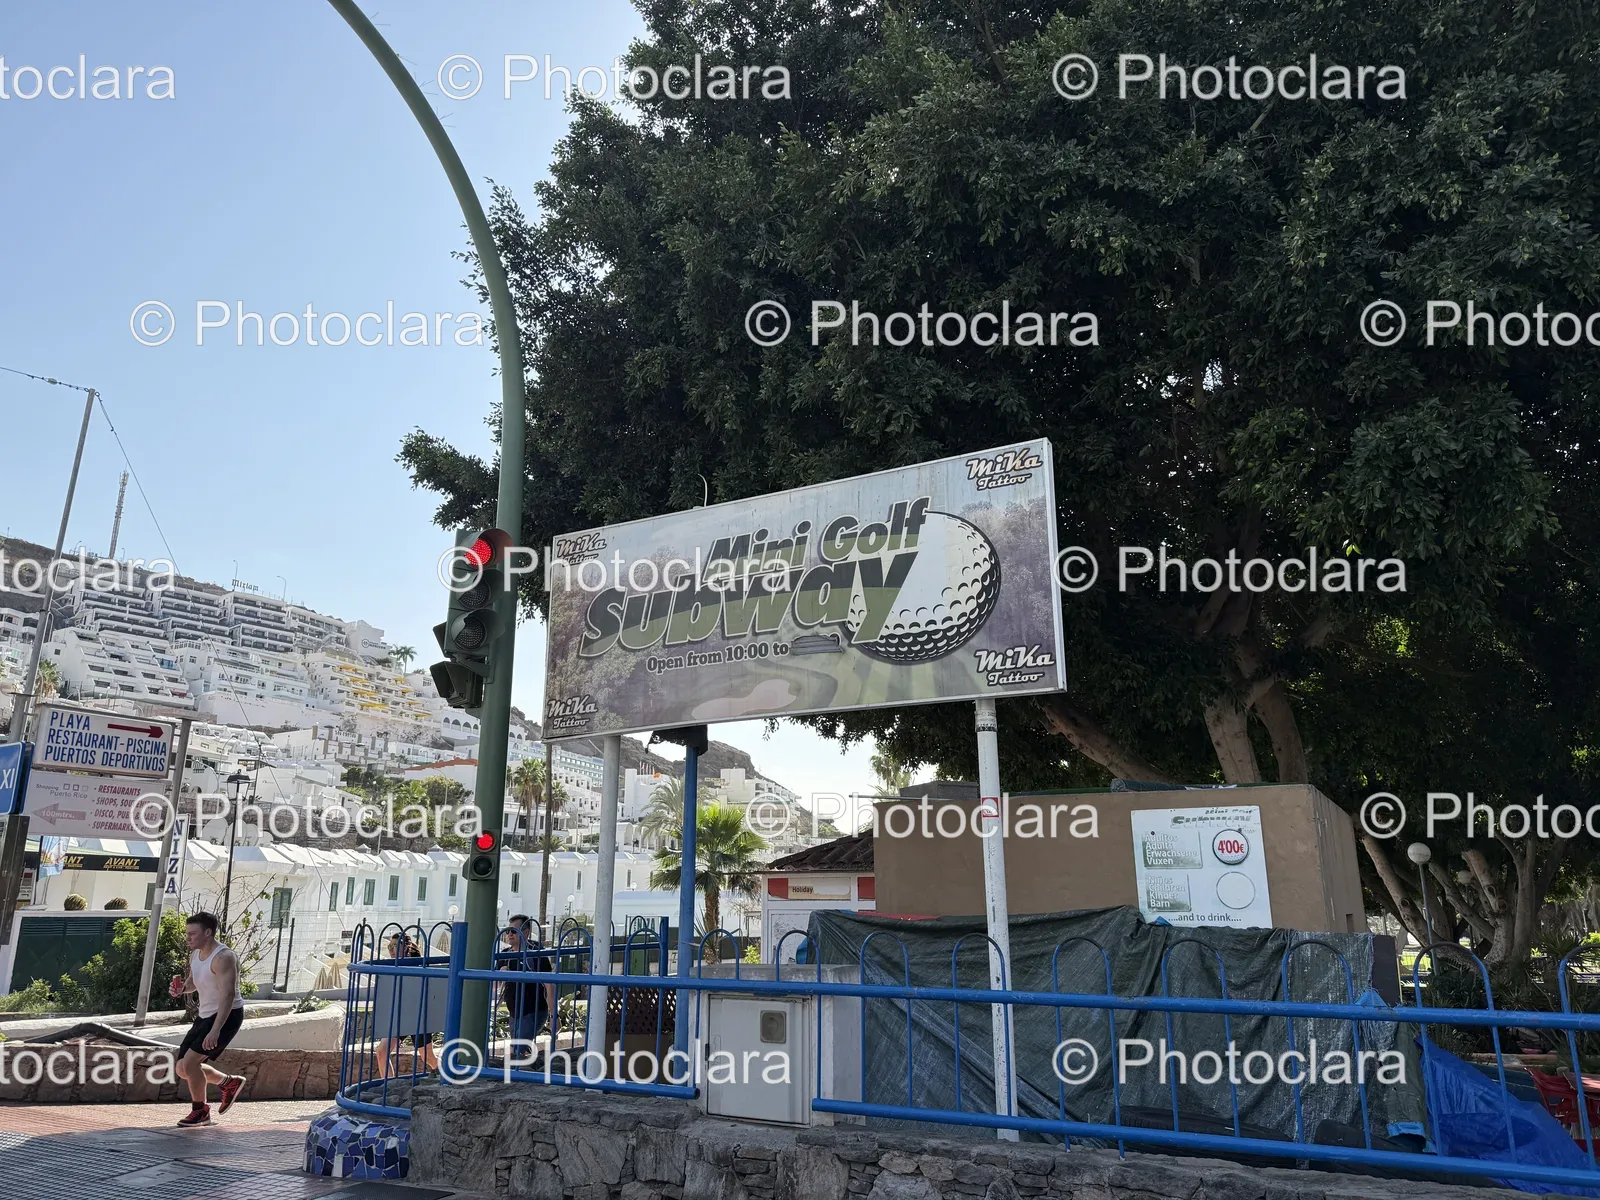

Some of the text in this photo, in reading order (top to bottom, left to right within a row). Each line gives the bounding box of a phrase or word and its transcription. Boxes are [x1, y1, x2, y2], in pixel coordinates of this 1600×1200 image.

[977, 473, 1032, 491] Tattoo
[703, 496, 931, 582] Mini Golf
[646, 641, 789, 675] Open from 10:00 to
[987, 671, 1045, 686] Tattoo
[50, 711, 91, 731] PLAYA
[552, 717, 589, 730] Tattoo
[44, 746, 166, 772] PUERTOS DEPORTIVOS
[36, 783, 60, 791] Shopping
[98, 785, 141, 796] RESTAURANTS
[50, 790, 88, 799] Puerto Rico
[96, 798, 118, 808] SHOPS,
[42, 810, 75, 819] 100mtrs.
[94, 810, 115, 820] DISCO,
[1145, 841, 1174, 850] Adults
[165, 818, 185, 894] NIZA
[104, 857, 140, 866] AVANT
[1147, 857, 1174, 865] Vuxen
[792, 886, 813, 894] Holiday
[1148, 883, 1186, 892] Children
[1149, 891, 1179, 900] Kinder
[1150, 899, 1170, 907] Barn
[1197, 914, 1206, 922] to
